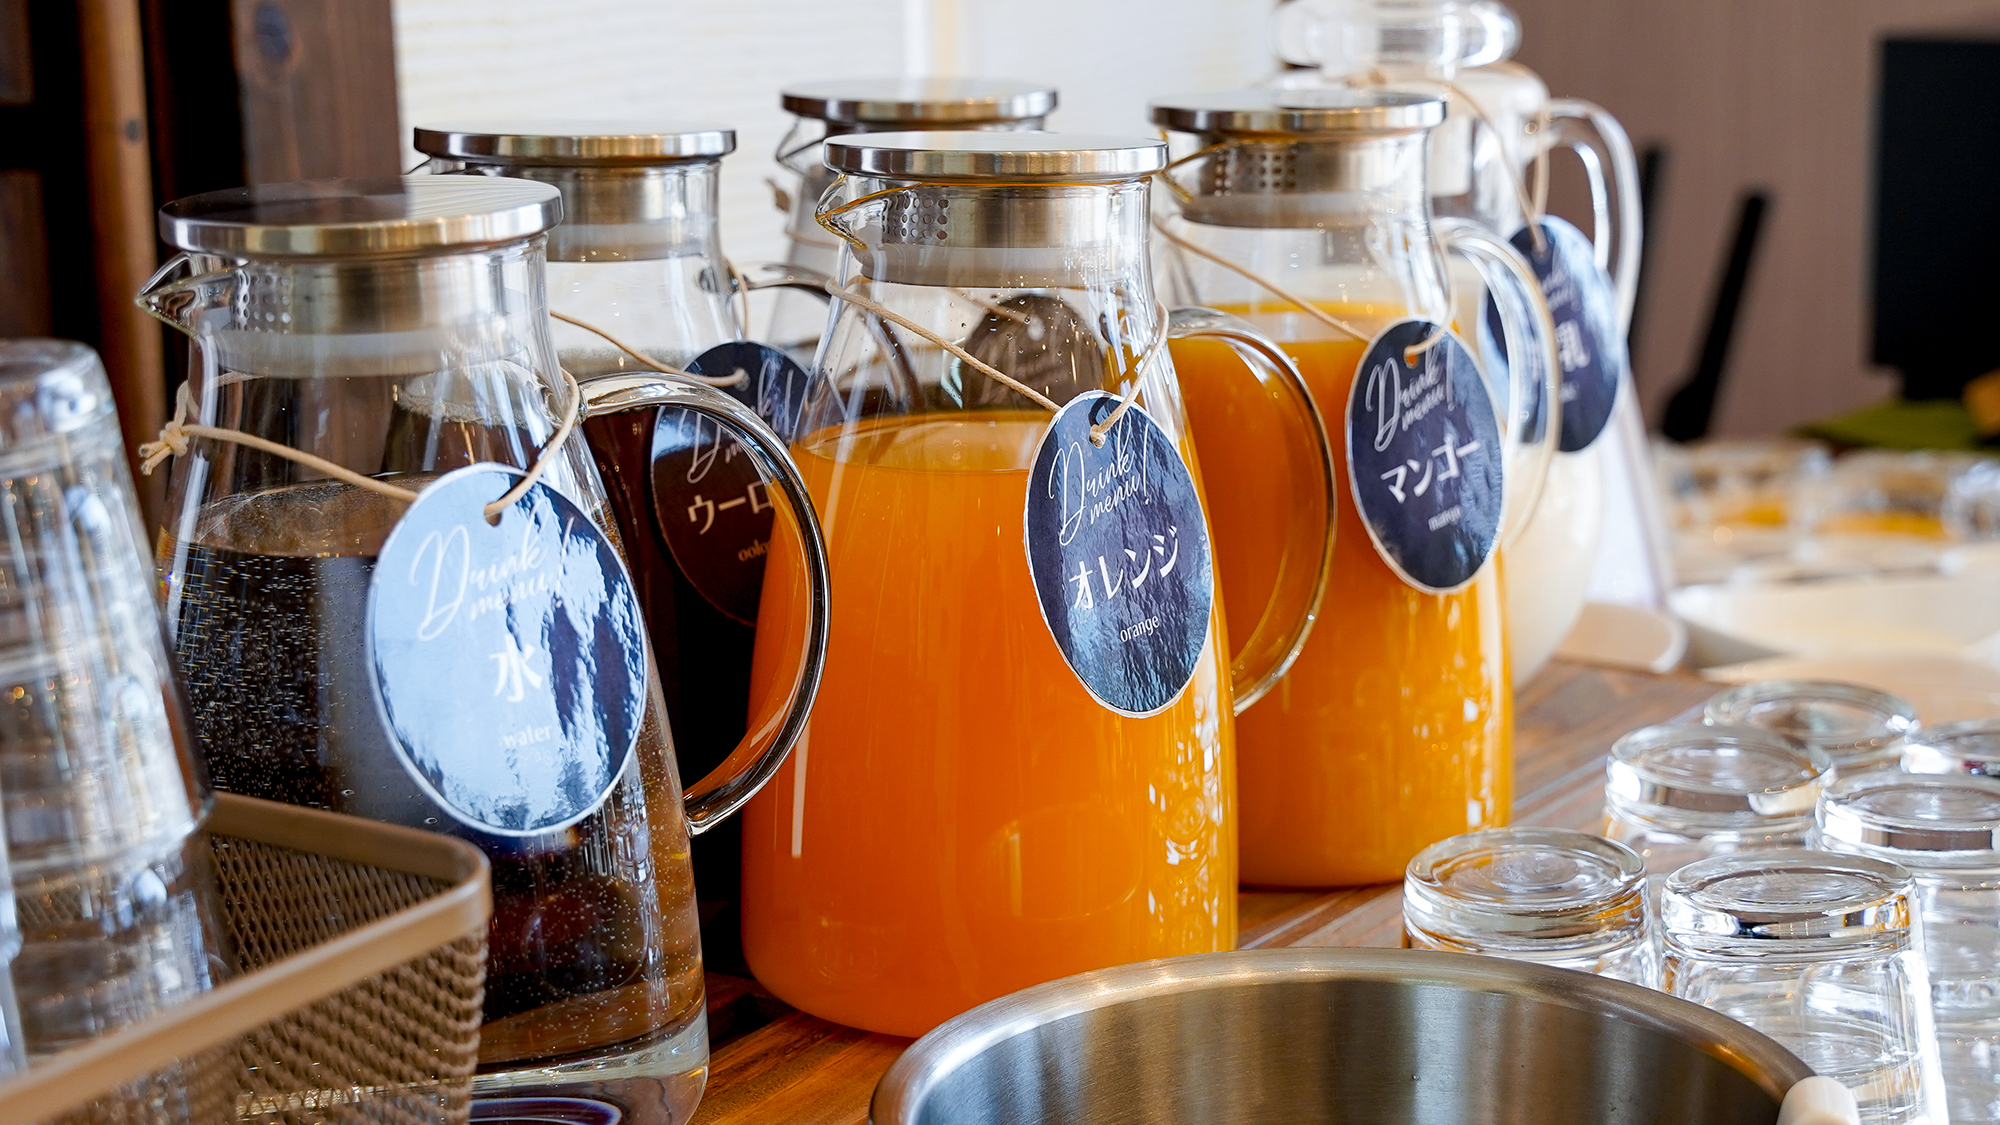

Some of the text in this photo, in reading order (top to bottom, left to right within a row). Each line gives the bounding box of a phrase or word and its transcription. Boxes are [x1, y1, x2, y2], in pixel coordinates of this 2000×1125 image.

[1364, 327, 1442, 452] Drink
[1048, 410, 1136, 546] Drink
[1380, 433, 1481, 504] マンゴー
[687, 481, 774, 535] ウーロ
[410, 498, 551, 641] Drink
[738, 539, 771, 562] oolo
[1069, 525, 1179, 610] オレンジ
[1120, 613, 1160, 643] orange
[489, 635, 543, 702] 水
[502, 725, 552, 748] water
